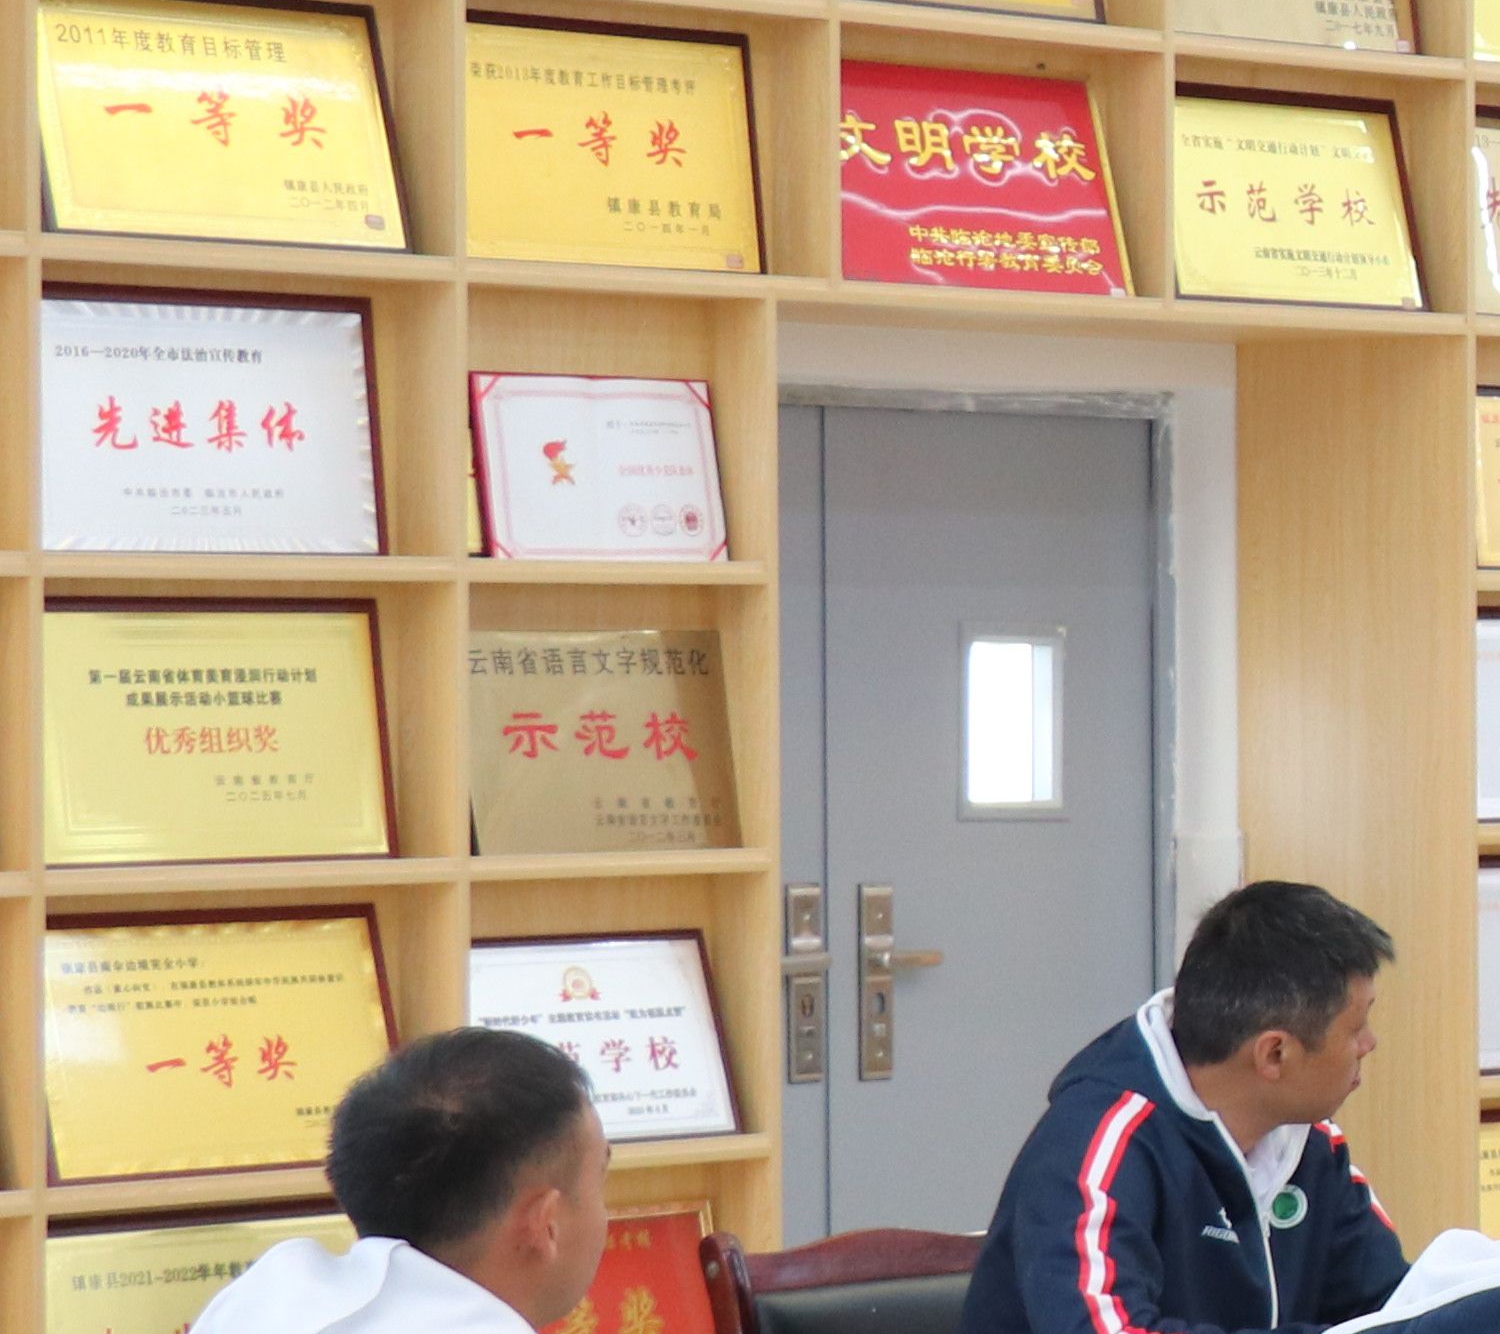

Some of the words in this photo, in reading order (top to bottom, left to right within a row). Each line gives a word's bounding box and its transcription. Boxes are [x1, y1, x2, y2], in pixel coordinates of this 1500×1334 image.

[56, 23, 287, 63] 2011年度教育目标管理
[104, 87, 327, 149] 一等奖
[513, 111, 687, 168] 一等奖
[839, 114, 1095, 181] 文明学校
[608, 197, 722, 219] 镇康县教育局
[1197, 179, 1376, 227] 示范学校
[92, 395, 305, 453] 先进集体
[468, 647, 709, 675] 云南省语言文字规范化
[144, 725, 279, 755] 优秀组织奖
[503, 711, 698, 760] 示范校
[147, 1034, 297, 1089] 一等奖
